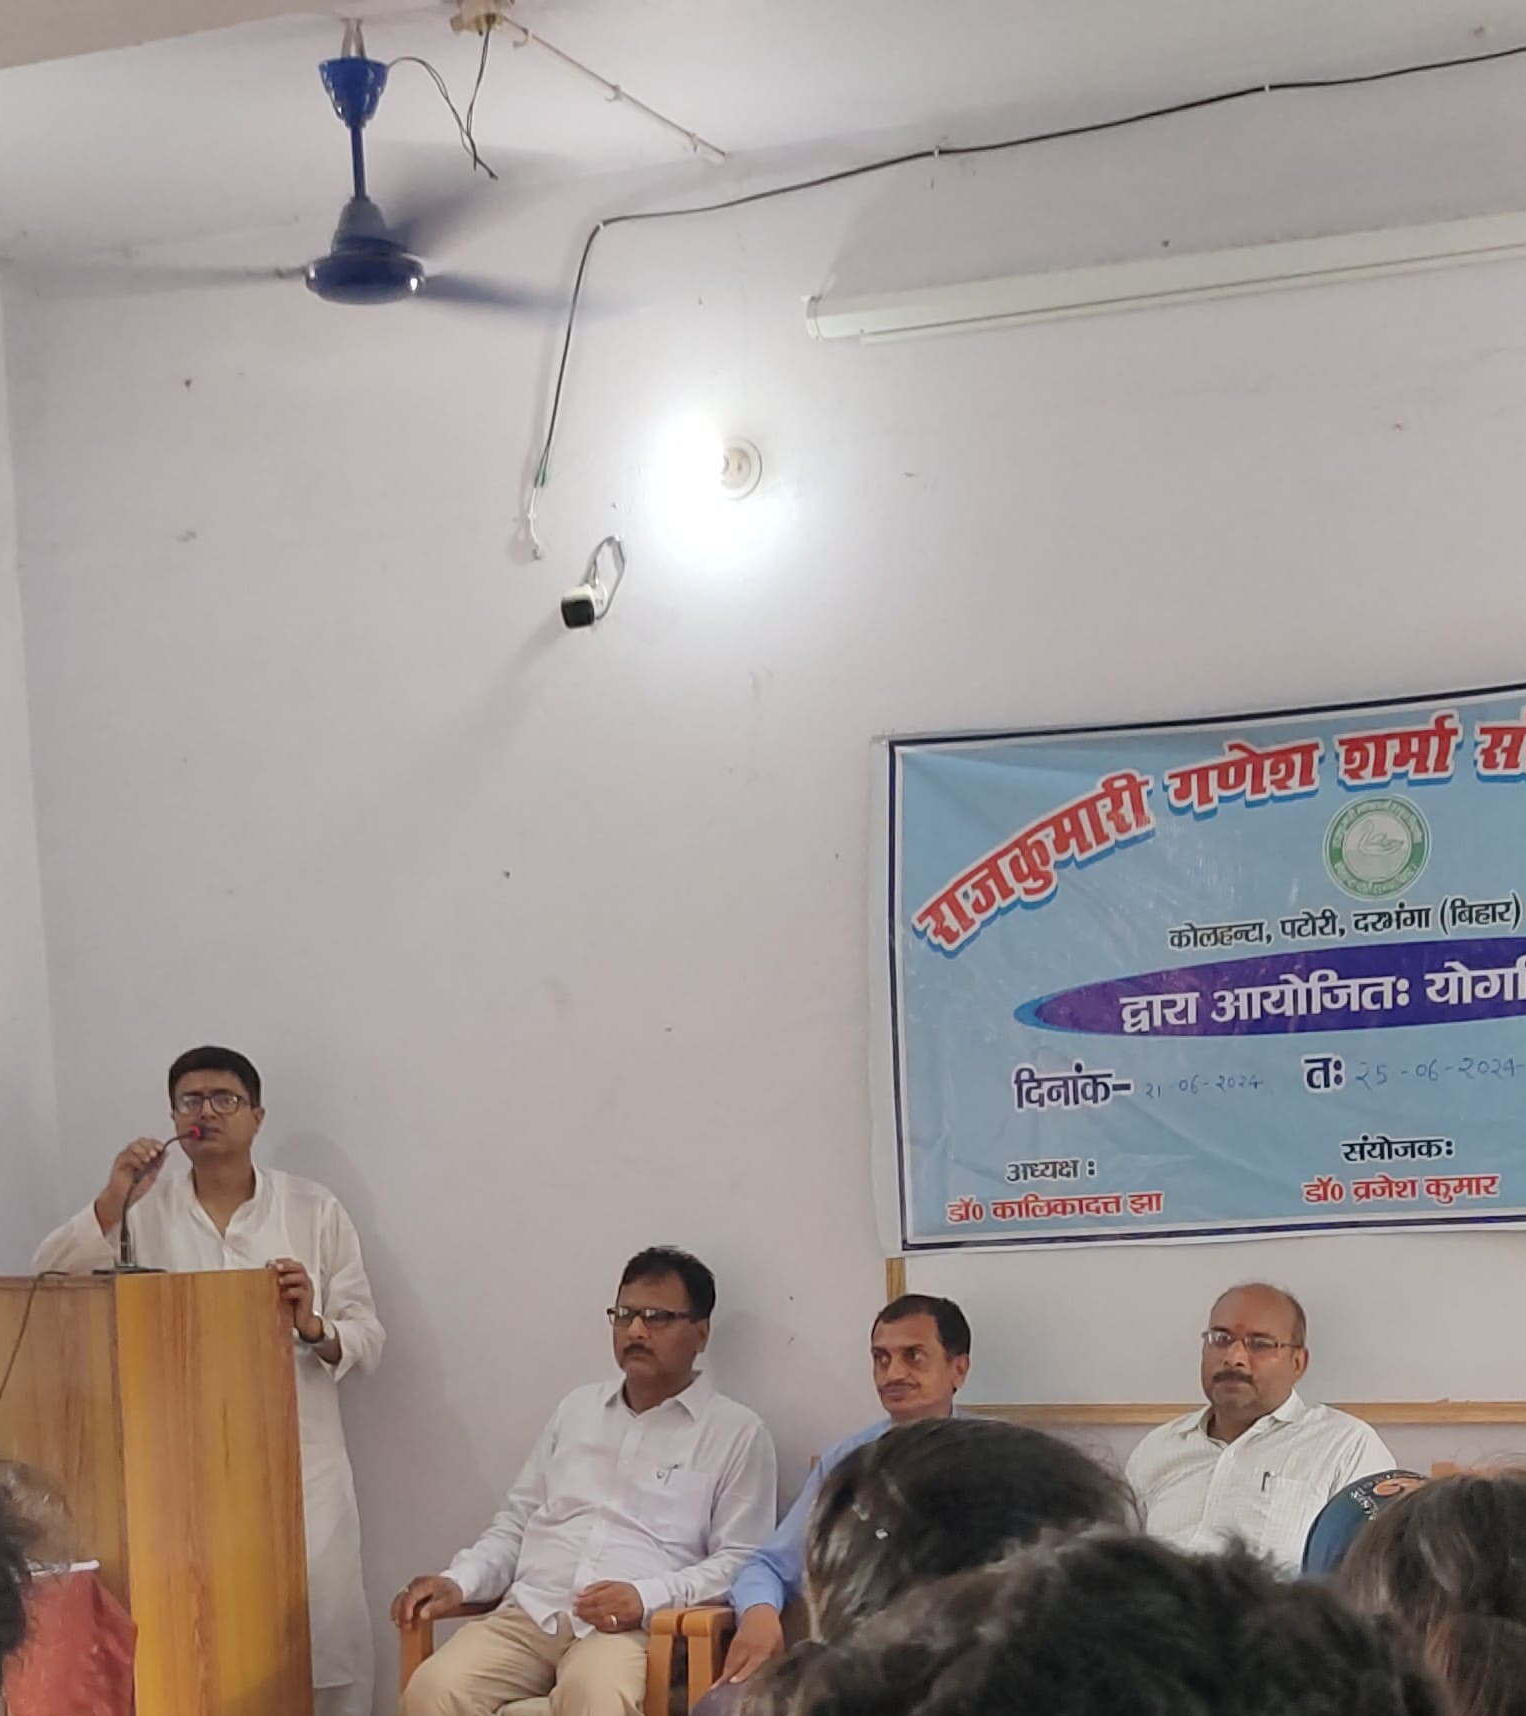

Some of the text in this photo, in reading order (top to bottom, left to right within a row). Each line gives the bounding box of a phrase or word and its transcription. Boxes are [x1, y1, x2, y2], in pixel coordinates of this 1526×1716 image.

[915, 772, 1154, 946] राजकुमारी
[1167, 742, 1323, 807] गणेश
[1337, 712, 1460, 781] शर्मा
[1169, 922, 1273, 949] कोलहन्टा,
[1279, 908, 1346, 939] पटोरी,
[1353, 902, 1431, 933] दरभंगा
[1439, 893, 1522, 935] (बिहार)
[1119, 990, 1200, 1034] द्वारा
[1129, 1192, 1163, 1212] झा
[1424, 1175, 1499, 1204] कुमार
